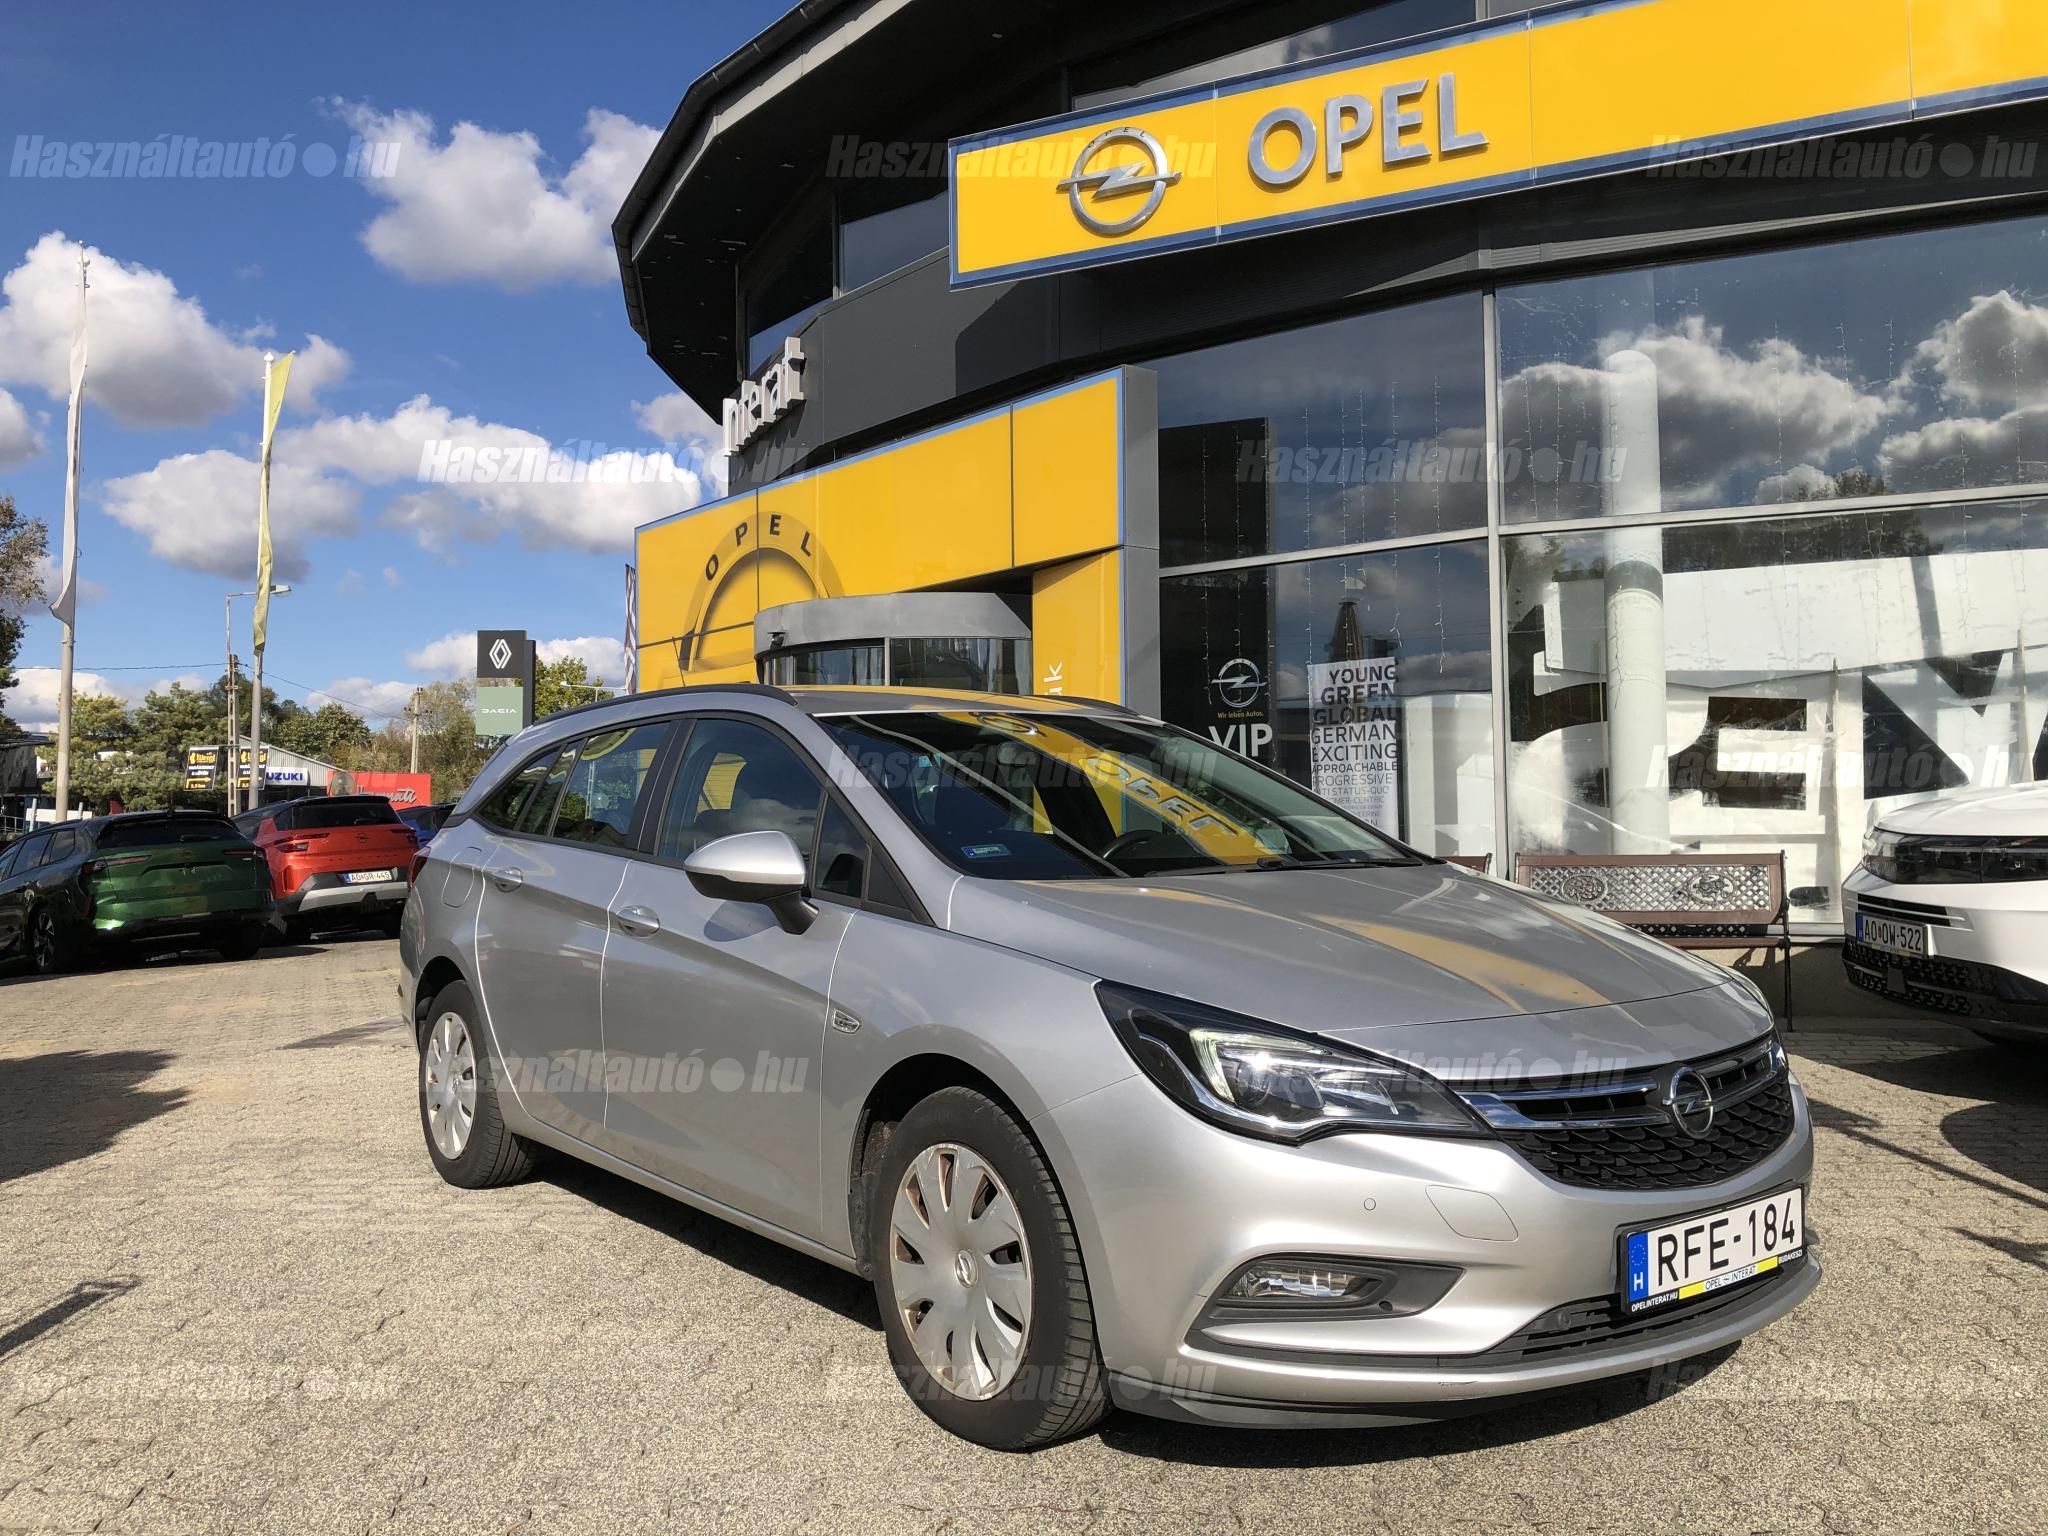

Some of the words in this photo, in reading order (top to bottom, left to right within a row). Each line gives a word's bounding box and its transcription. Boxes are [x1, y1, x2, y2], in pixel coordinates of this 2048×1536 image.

[1248, 72, 1489, 185] OPEL
[705, 514, 812, 581] OPEL
[1329, 664, 1398, 685] YOUNG
[1320, 682, 1395, 706] GREEN
[1218, 711, 1227, 719] Wir
[1228, 711, 1245, 719] leben
[1313, 703, 1397, 726] GLOBAL
[1208, 723, 1273, 757] VIP
[1311, 723, 1396, 744] GERMAN
[1312, 742, 1398, 762] EXCITING
[266, 772, 303, 781] UZUKI
[1312, 761, 1398, 774] APPROACHABLE
[1312, 773, 1393, 786] PROGRESSIVE
[1633, 1272, 1644, 1291] H
[1657, 1198, 1795, 1287] RFE-184
[1705, 1278, 1722, 1291] OPEL
